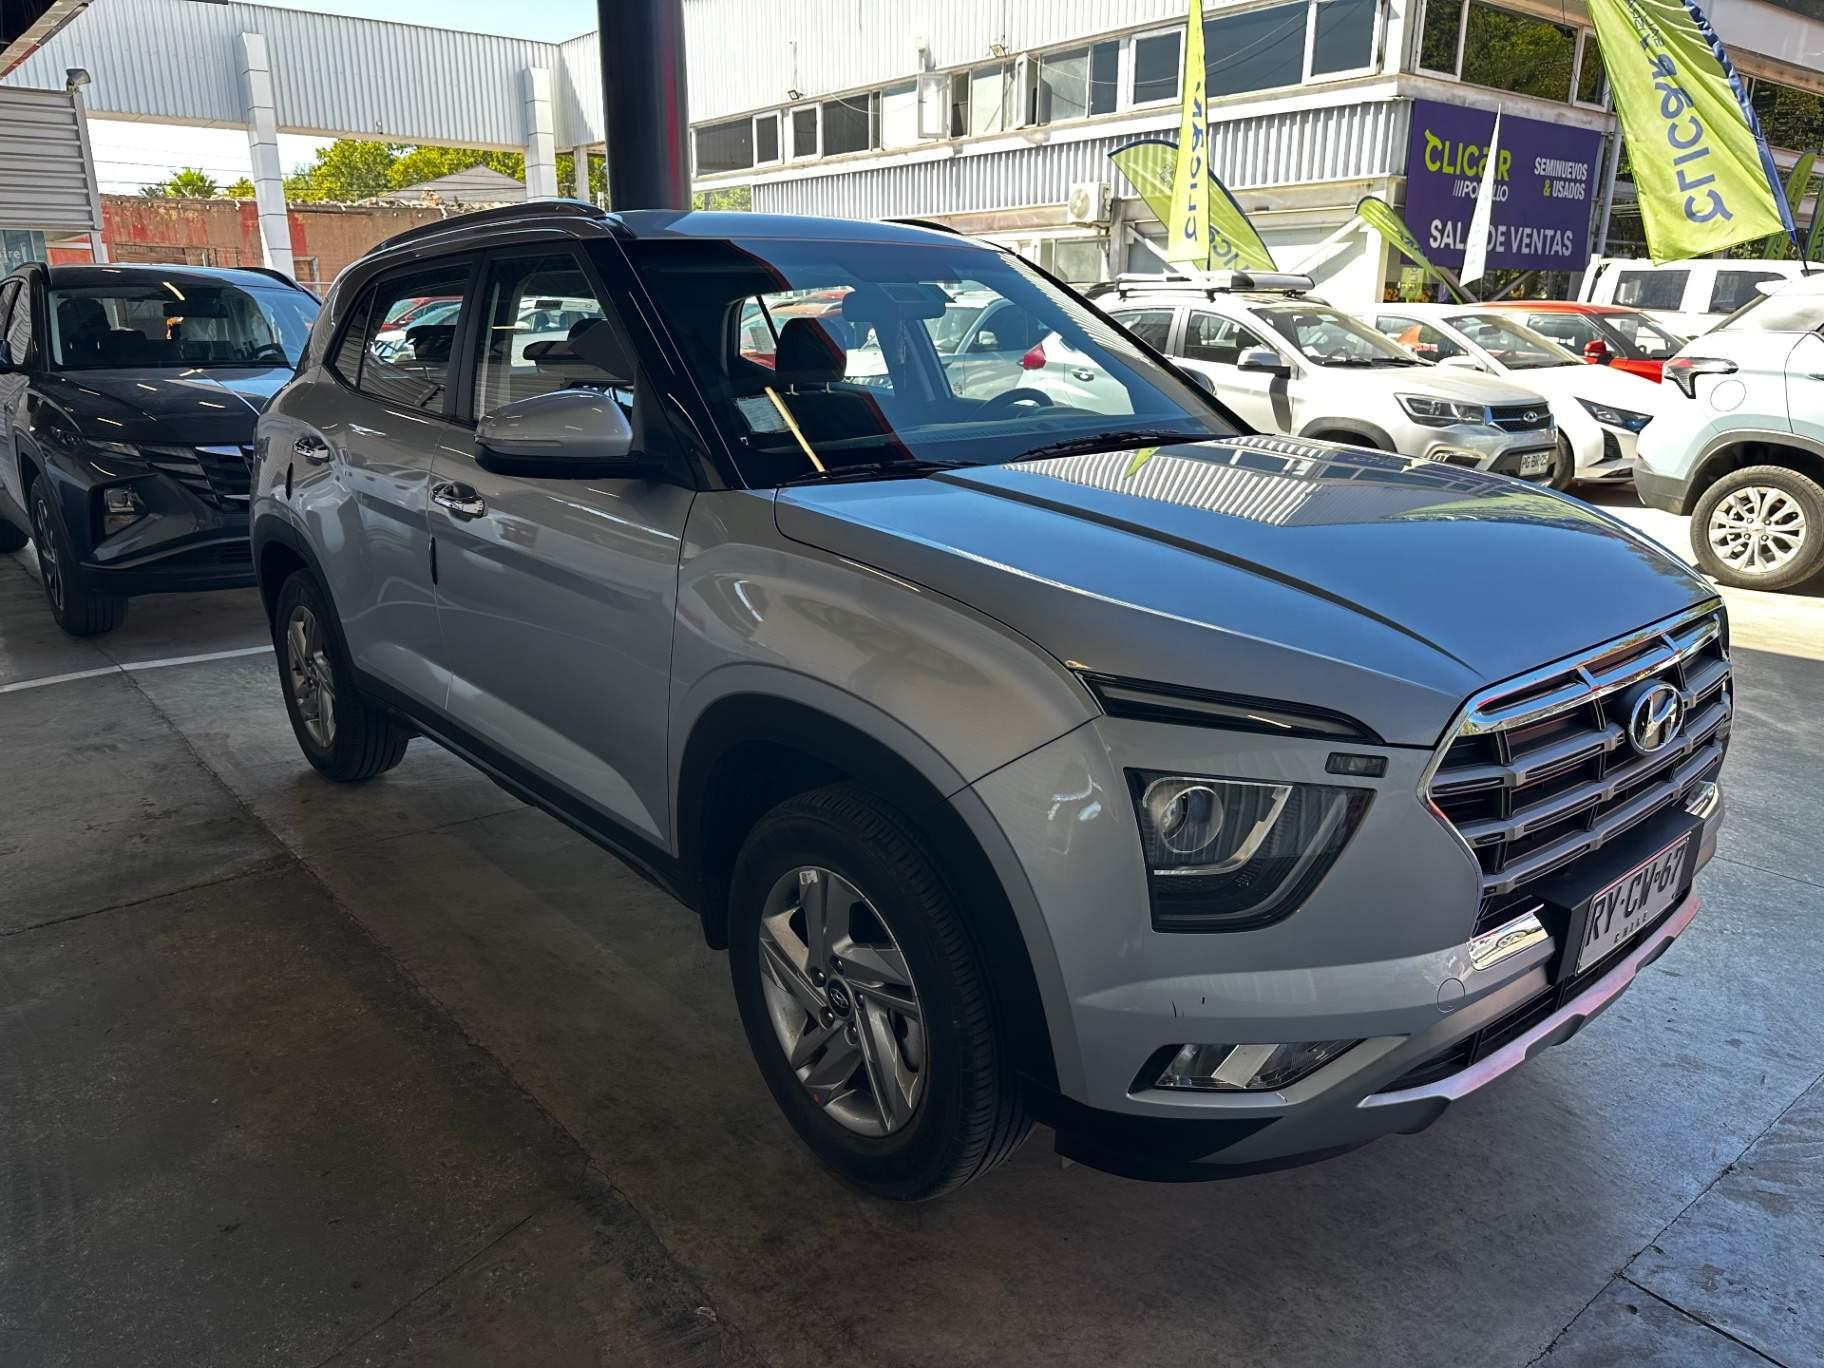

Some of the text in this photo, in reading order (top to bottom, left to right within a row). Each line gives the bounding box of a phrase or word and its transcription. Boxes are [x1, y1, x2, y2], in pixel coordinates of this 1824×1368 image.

[1534, 157, 1588, 180] SEMINUEVOS
[1543, 181, 1585, 200] & USADOS
[1429, 219, 1468, 249] SAL
[1510, 226, 1573, 256] VENTAS
